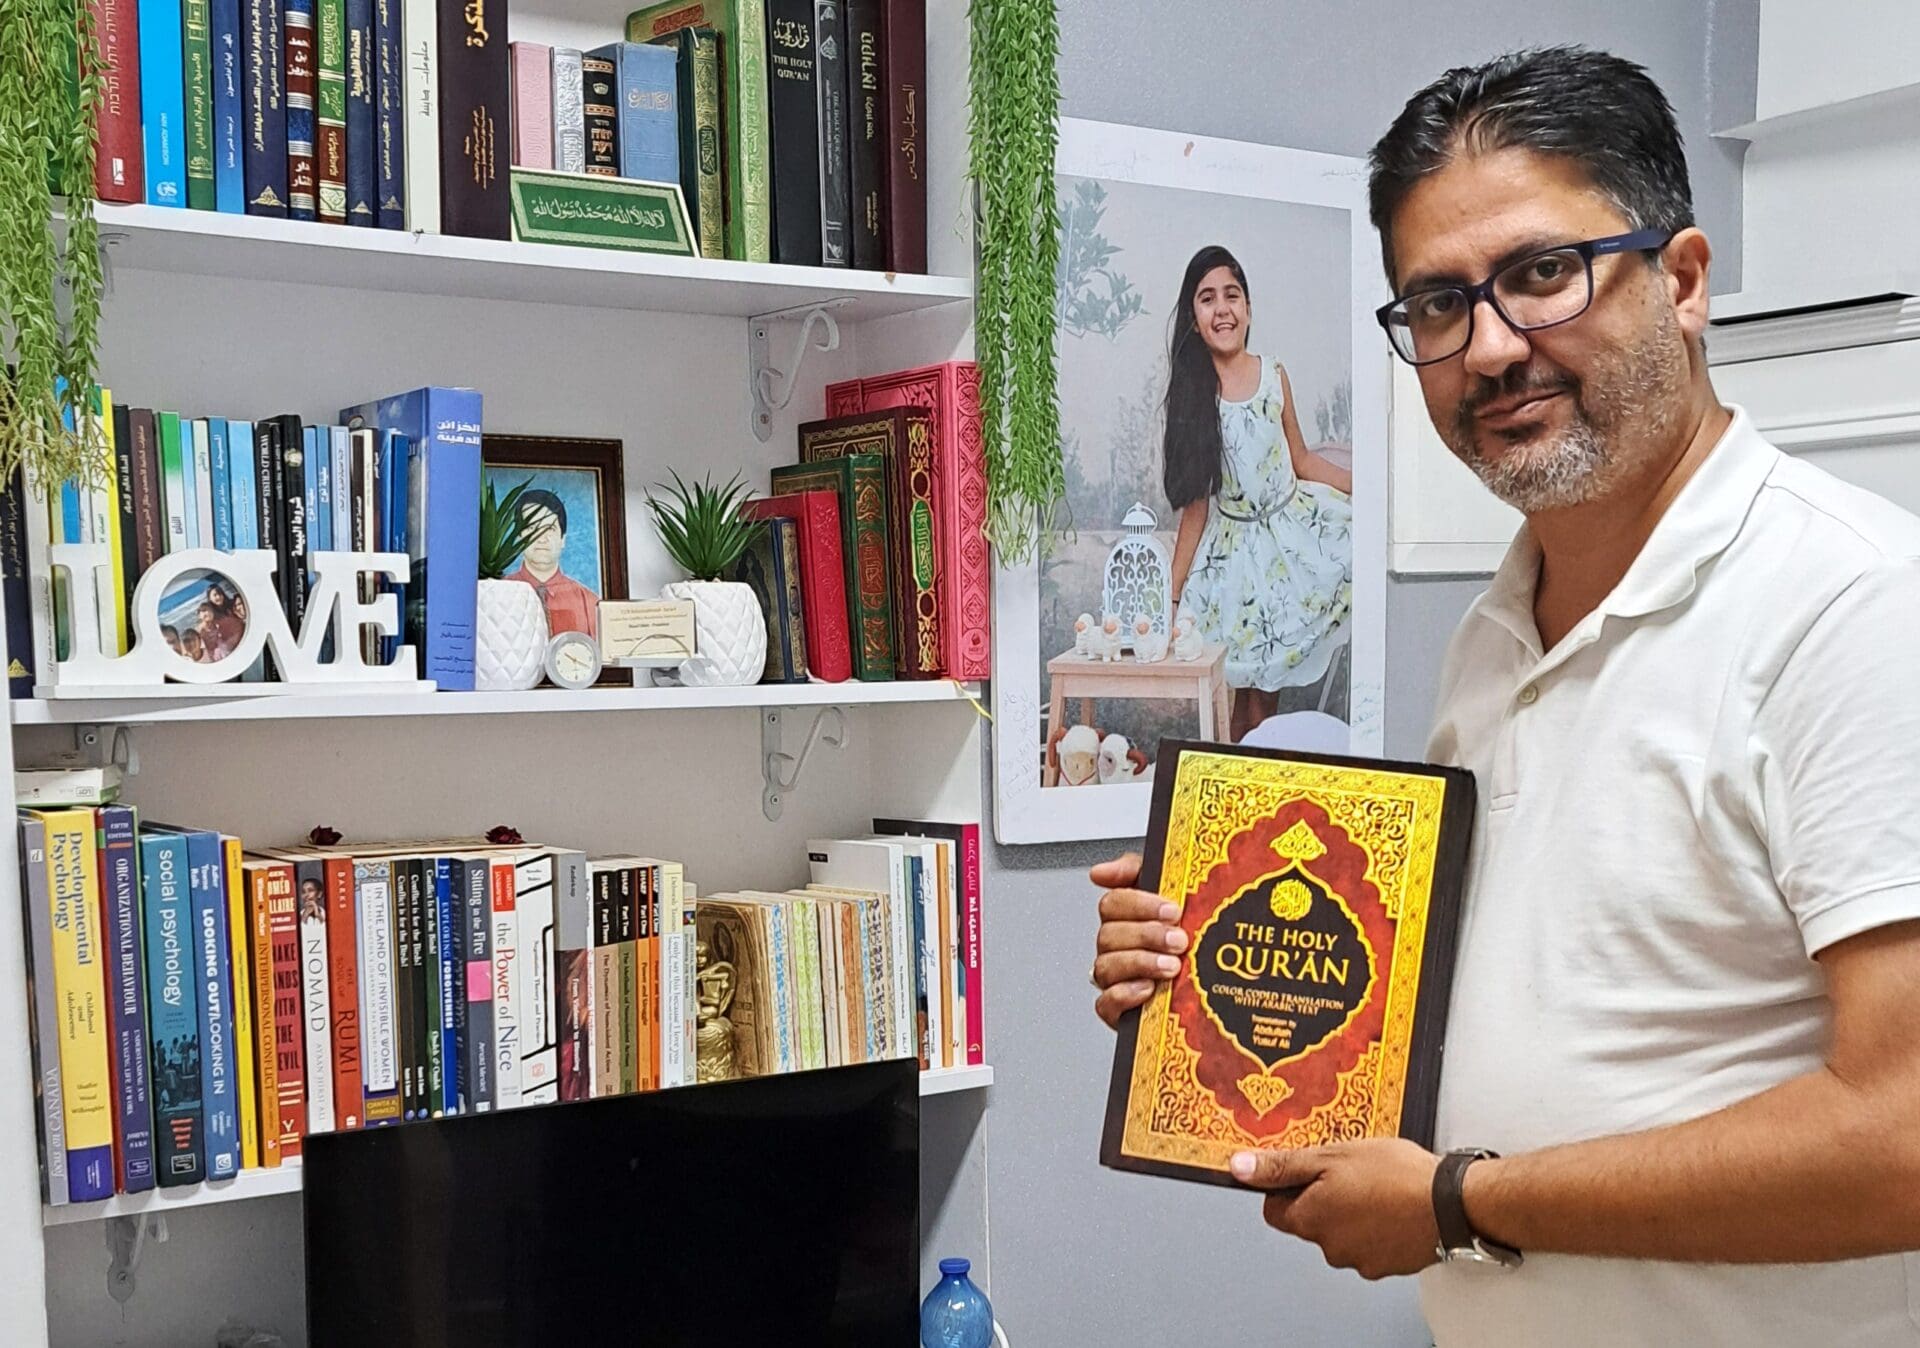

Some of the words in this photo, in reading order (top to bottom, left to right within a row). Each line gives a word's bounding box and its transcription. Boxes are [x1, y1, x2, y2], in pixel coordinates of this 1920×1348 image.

[464, 0, 489, 47] ذكرة
[773, 54, 788, 66] THE
[790, 57, 813, 69] HOLY
[777, 68, 810, 81] QUR'AN
[260, 434, 271, 467] WORLD
[261, 468, 271, 497] CRISIS
[288, 496, 305, 525] شروط
[47, 543, 417, 684] LOVE
[50, 832, 71, 934] Psychology
[159, 849, 178, 901] social
[200, 863, 210, 891] Towne
[211, 864, 220, 889] Adler
[336, 871, 348, 910] BARKS
[468, 869, 486, 907] Sitting
[600, 875, 609, 901] SHARP
[620, 870, 629, 897] SHARP
[639, 869, 648, 896] SHARP
[69, 831, 93, 966] Developmental
[115, 856, 134, 953] ORGANIZATIONAL
[375, 886, 384, 900] IN
[375, 902, 385, 924] THE
[472, 908, 481, 917] in
[473, 917, 483, 931] the
[202, 908, 218, 978] LOOKING
[376, 928, 387, 960] LAND
[441, 901, 452, 959] EXPLORING
[473, 931, 487, 956] Fire
[496, 922, 513, 946] the
[1235, 922, 1275, 944] THE
[1282, 928, 1339, 951] HOLY
[160, 909, 182, 1007] psychology
[672, 941, 682, 958] only
[377, 962, 388, 979] OF
[496, 948, 517, 1003] Power
[672, 960, 681, 974] say
[673, 975, 682, 991] this
[121, 953, 137, 1016] BEHAVIOUR
[259, 942, 272, 1032] INTERPERSONAL
[306, 939, 327, 1033] NOMAD
[443, 960, 455, 1030] FORGIVENESS
[1211, 983, 1244, 998] COLOR
[1245, 988, 1279, 1002] CODED
[1281, 993, 1345, 1010] TRANSLATION
[85, 991, 96, 1034] Childhood
[378, 981, 391, 1035] INVISIBLE
[498, 1006, 514, 1021] of
[673, 992, 682, 1024] because
[1234, 995, 1257, 1007] WITH
[1261, 998, 1295, 1013] ARABIC
[1297, 1003, 1320, 1017] TEXT
[206, 981, 224, 1078] OUT/LOOKING
[335, 1009, 358, 1075] RUMI
[673, 1030, 682, 1048] love
[133, 1029, 143, 1087] UNDERSTANDING
[263, 1033, 276, 1092] CONFLICT
[380, 1036, 392, 1084] WOMEN
[498, 1026, 519, 1072] Nice
[672, 1048, 681, 1065] you
[45, 1067, 60, 1131] CANADA
[212, 1079, 225, 1096] IN
